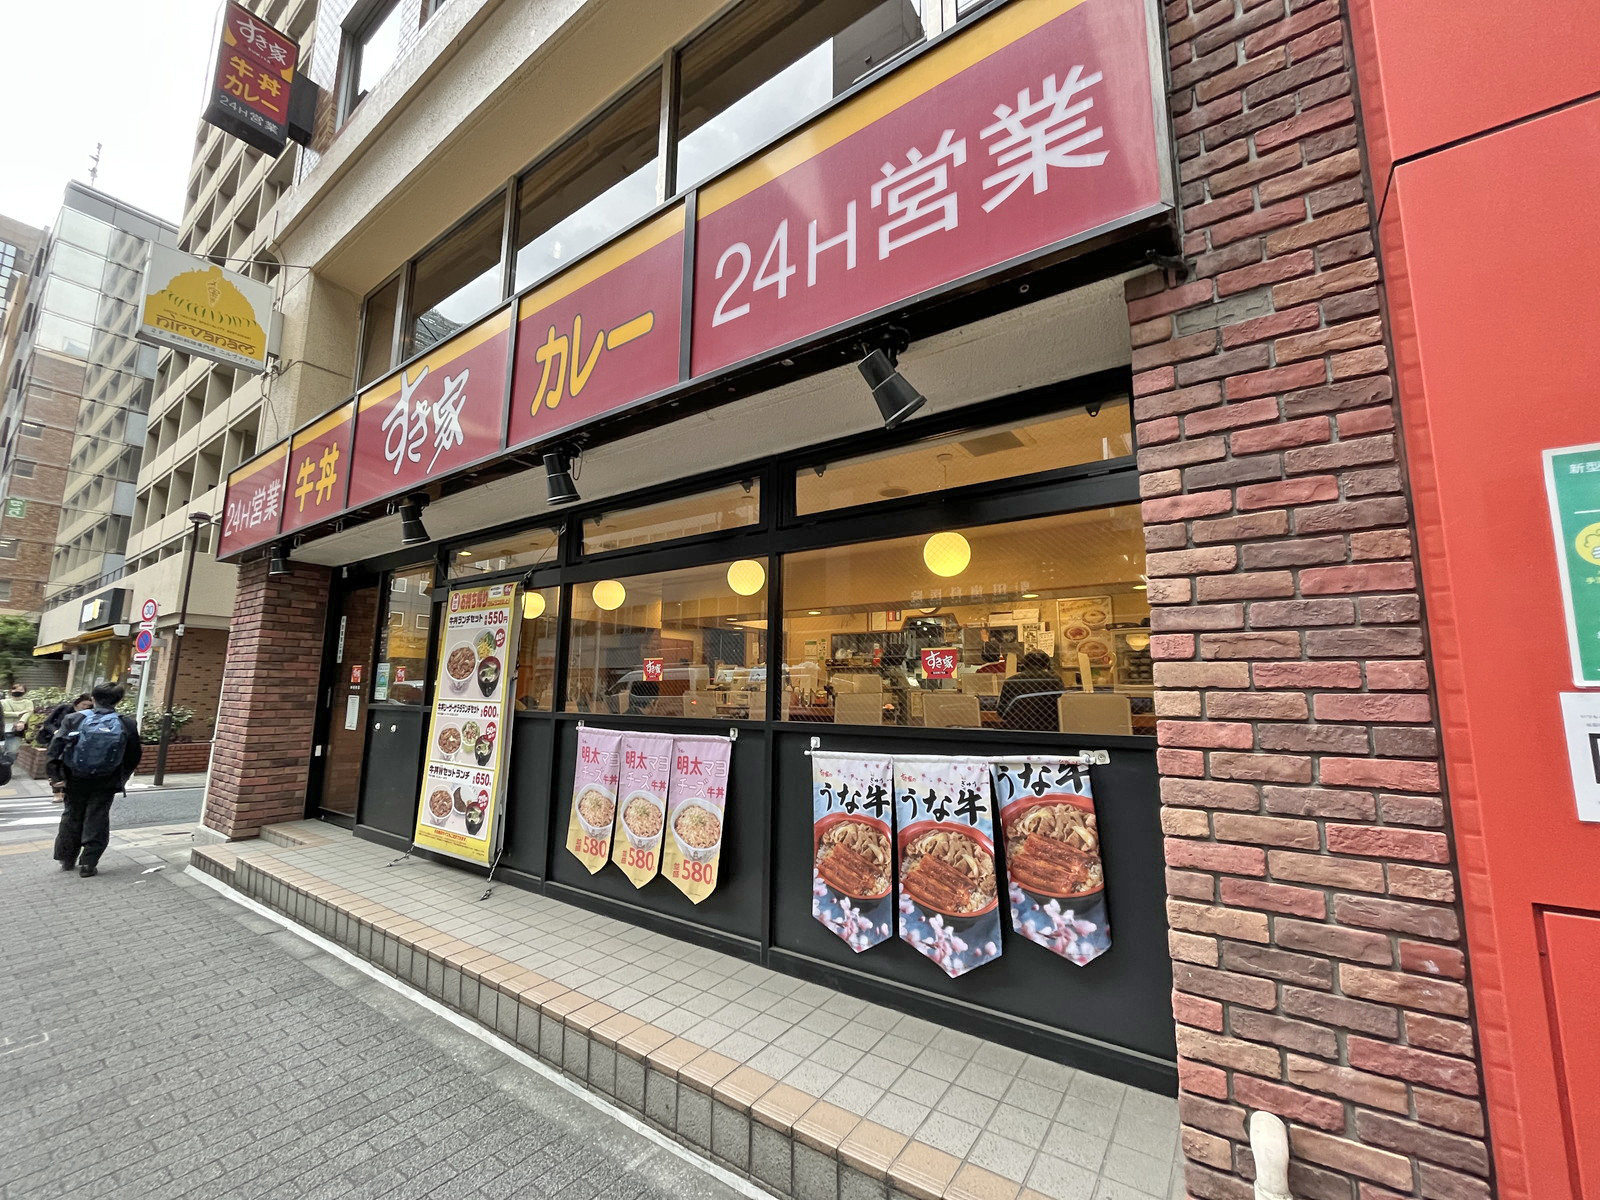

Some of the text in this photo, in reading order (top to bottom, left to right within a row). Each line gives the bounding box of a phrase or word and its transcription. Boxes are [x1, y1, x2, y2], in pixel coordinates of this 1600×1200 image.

[236, 18, 287, 66] すき家
[224, 74, 280, 113] カレー
[229, 56, 281, 97] 牛丼
[219, 94, 279, 136] 24H営業
[712, 64, 1110, 328] 24H営業
[156, 314, 256, 356] nirvanam
[530, 310, 655, 418] カレー
[381, 366, 469, 475] すき家
[295, 442, 339, 513] 牛丼
[224, 479, 281, 537] 24H営業
[145, 605, 154, 616] 30
[925, 650, 953, 672] すき家
[626, 751, 669, 772] 明太マヨ
[676, 755, 727, 778] 明太マヨ
[997, 763, 1090, 800] うな牛
[820, 782, 890, 818] うな牛
[901, 788, 987, 826] うな牛
